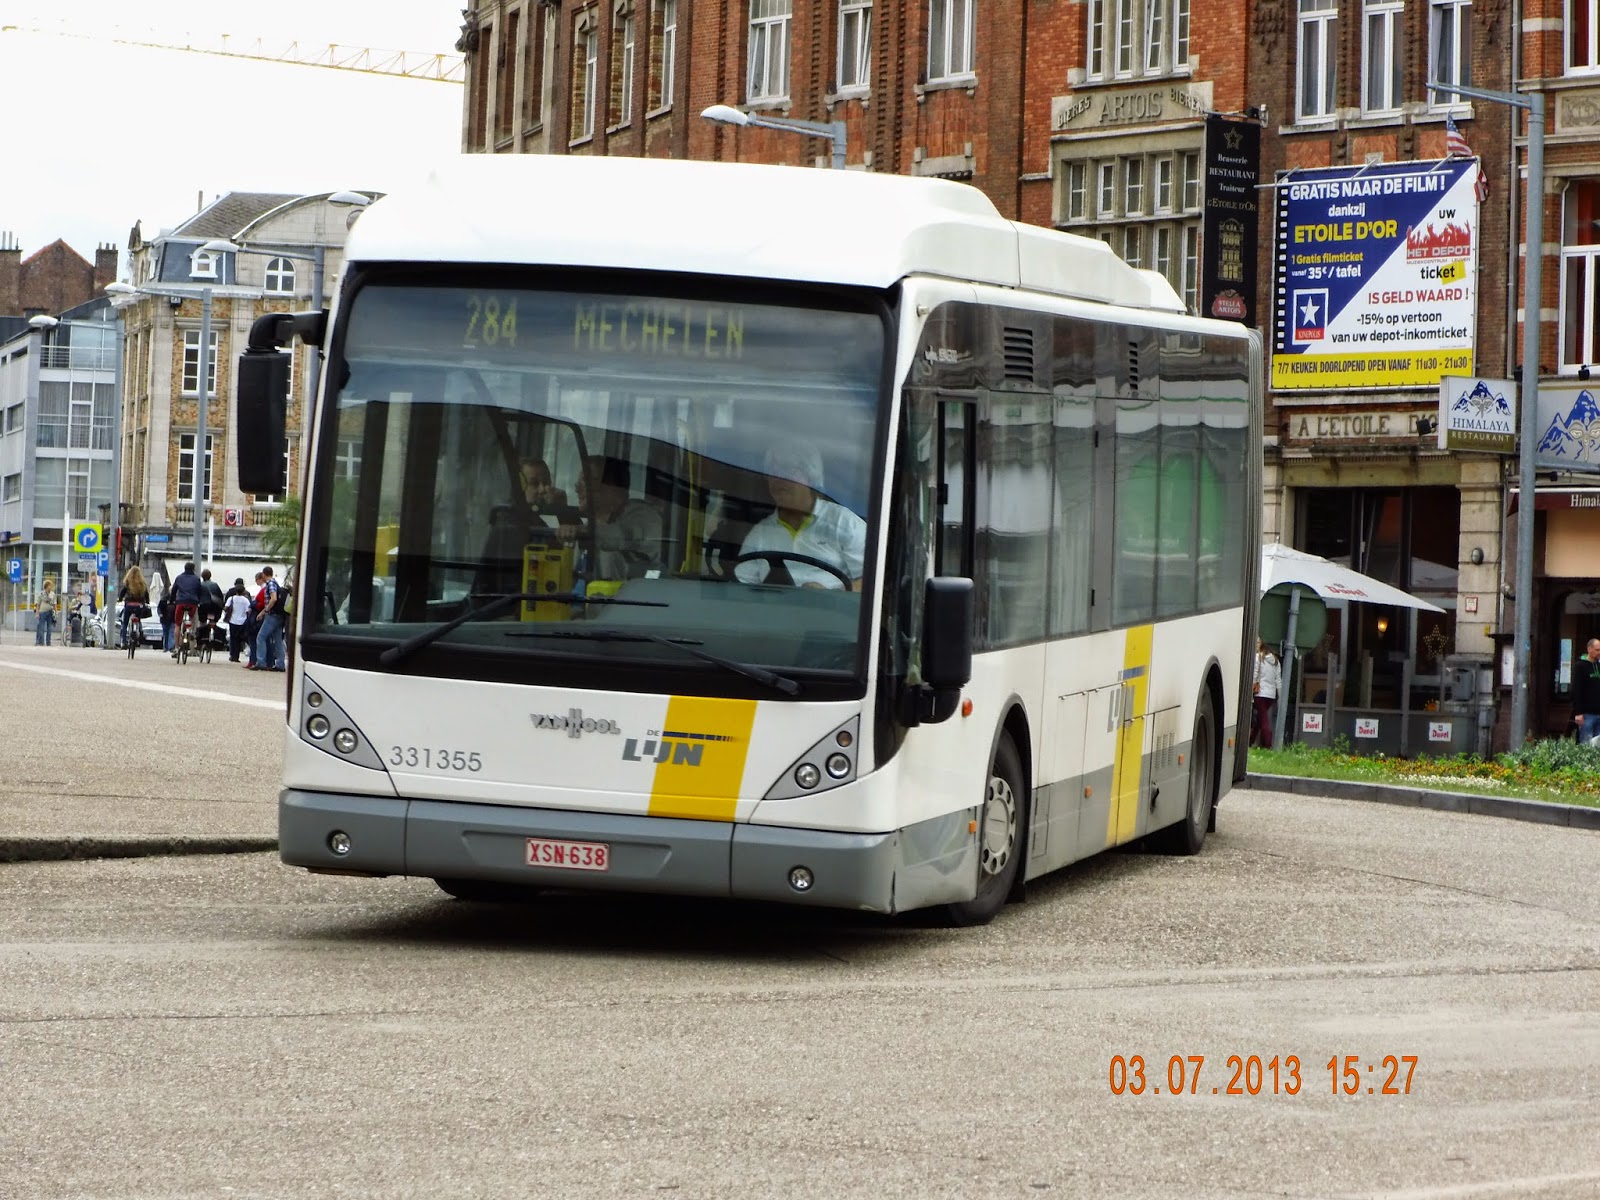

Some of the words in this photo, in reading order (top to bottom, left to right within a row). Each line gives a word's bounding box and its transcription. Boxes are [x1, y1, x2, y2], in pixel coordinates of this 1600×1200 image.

[1057, 96, 1091, 128] BIERES
[1099, 92, 1163, 122] ARTOIS
[1217, 153, 1248, 164] Brasserie
[1209, 167, 1256, 179] RESTAURANT
[1218, 183, 1246, 193] Traiteur
[1290, 181, 1340, 201] GRATIS
[1341, 178, 1382, 197] NAAR
[1384, 177, 1403, 194] DE
[1404, 175, 1438, 192] FILM
[1328, 203, 1366, 218] dankzij
[1294, 222, 1353, 243] ETOILE
[1356, 219, 1398, 240] D'OR
[1296, 253, 1322, 264] Gratis
[1322, 251, 1364, 263] filmticket
[1407, 247, 1428, 258] HET
[1431, 245, 1470, 257] DEPOT
[1291, 269, 1307, 277] vanaf
[1336, 265, 1361, 278] tafel
[1420, 265, 1455, 279] ticket
[1368, 292, 1380, 304] IS
[1381, 291, 1414, 304] GELD
[1416, 288, 1463, 303] WAARD
[1218, 306, 1241, 314] ARTOIS
[1356, 311, 1384, 325] -15%
[1386, 315, 1399, 326] op
[1401, 312, 1442, 323] vertoon
[464, 295, 517, 345] 284
[575, 302, 745, 359] MECHELEN
[1331, 333, 1351, 343] van
[1352, 333, 1368, 342] uw
[1369, 326, 1467, 344] depot-inkomticket
[1278, 362, 1289, 375] 7/7
[1291, 361, 1317, 374] KEUKEN
[1319, 360, 1366, 374] DOORLOPEND
[1367, 359, 1387, 372] OPEN
[1388, 358, 1412, 371] VANAF
[1415, 358, 1438, 370] 11u30
[1444, 356, 1468, 370] 21u30
[1298, 416, 1309, 437] A
[1317, 414, 1391, 436] L'ETOILE
[1452, 417, 1510, 432] HIMALAYA
[1451, 431, 1510, 442] RESTAURANT
[1570, 494, 1600, 507] Himal
[1305, 721, 1320, 730] Duvel
[1358, 726, 1376, 735] Duvel
[646, 729, 661, 737] DE
[1432, 729, 1449, 738] Duvel
[390, 745, 483, 773] 331355
[622, 738, 704, 767] LIJN
[529, 842, 607, 869] XSN-638
